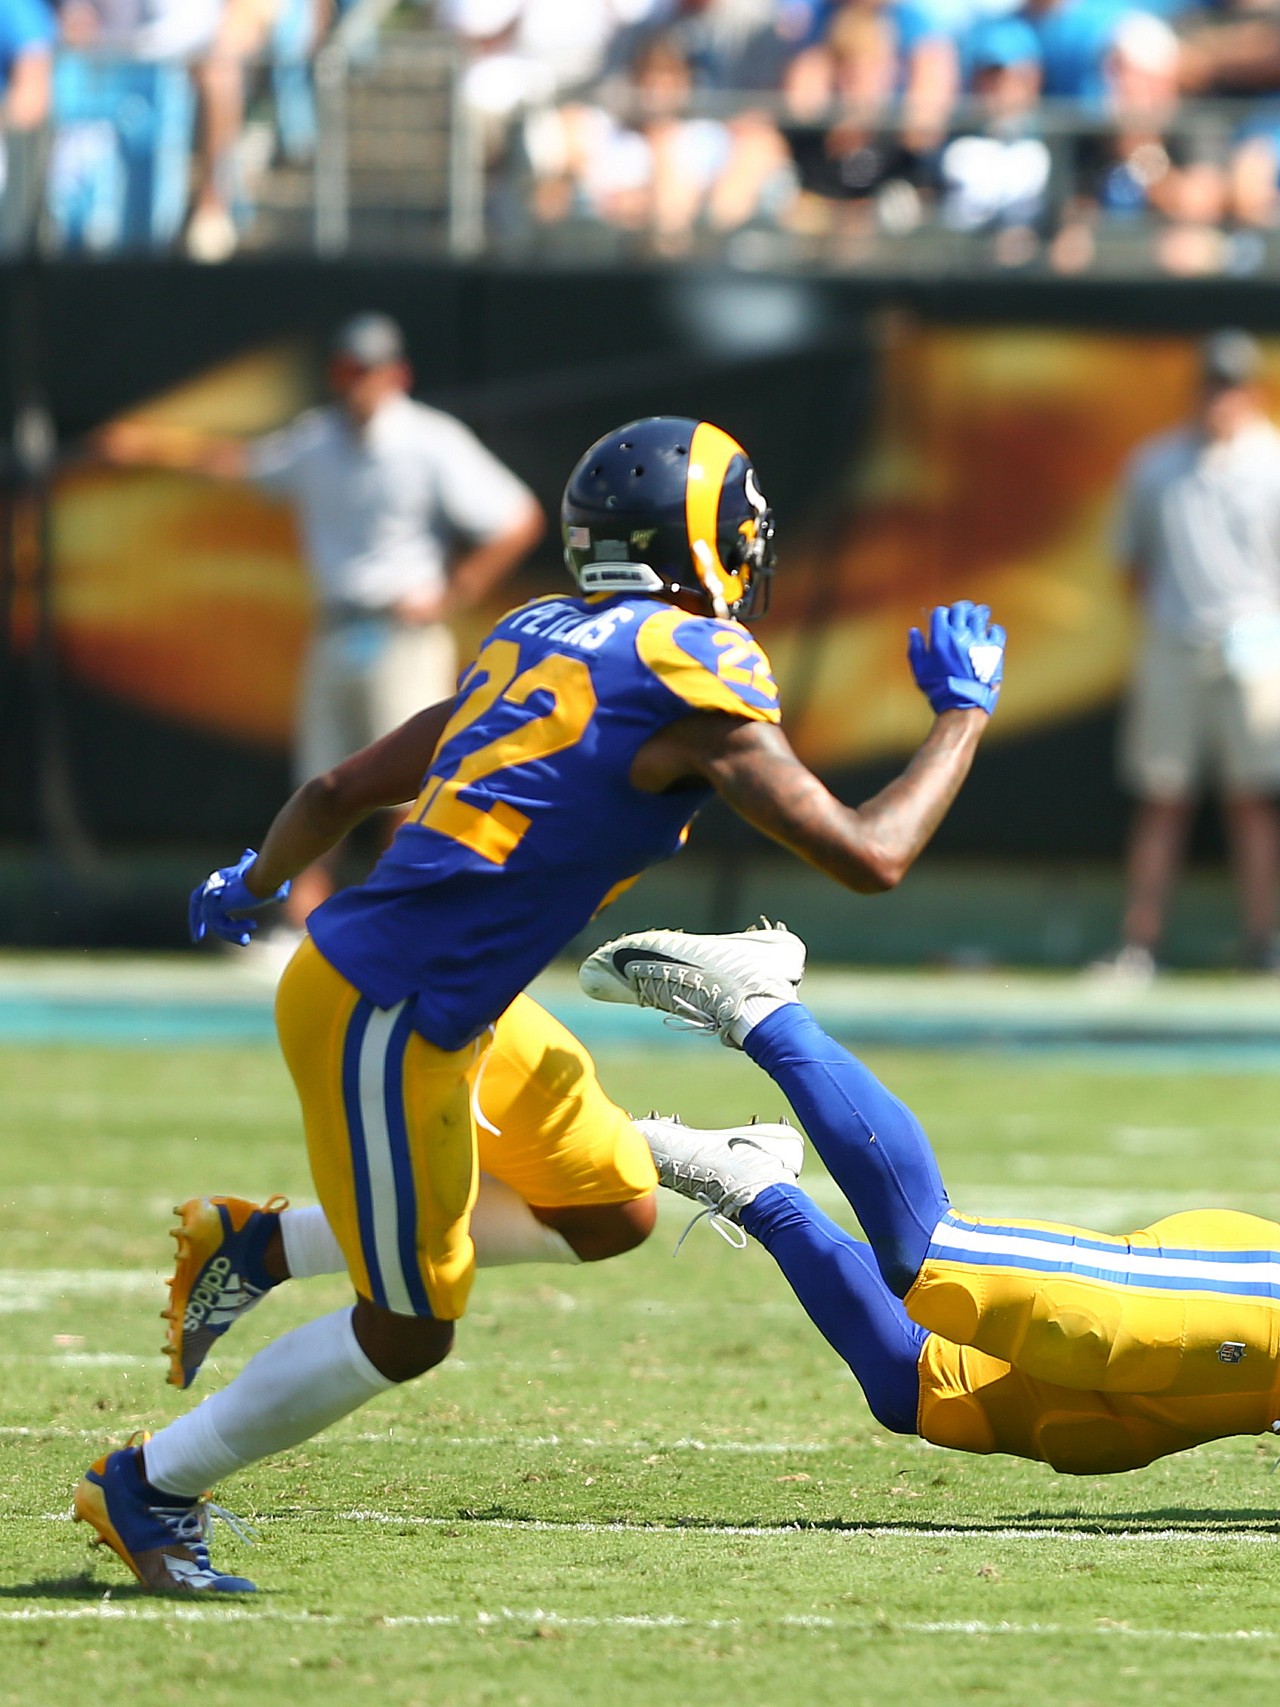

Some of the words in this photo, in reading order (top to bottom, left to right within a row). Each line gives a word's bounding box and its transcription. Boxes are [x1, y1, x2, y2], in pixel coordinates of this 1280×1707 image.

[509, 601, 634, 650] PETERS
[711, 630, 779, 700] 22
[406, 639, 598, 866] 22
[184, 1256, 231, 1332] adidas
